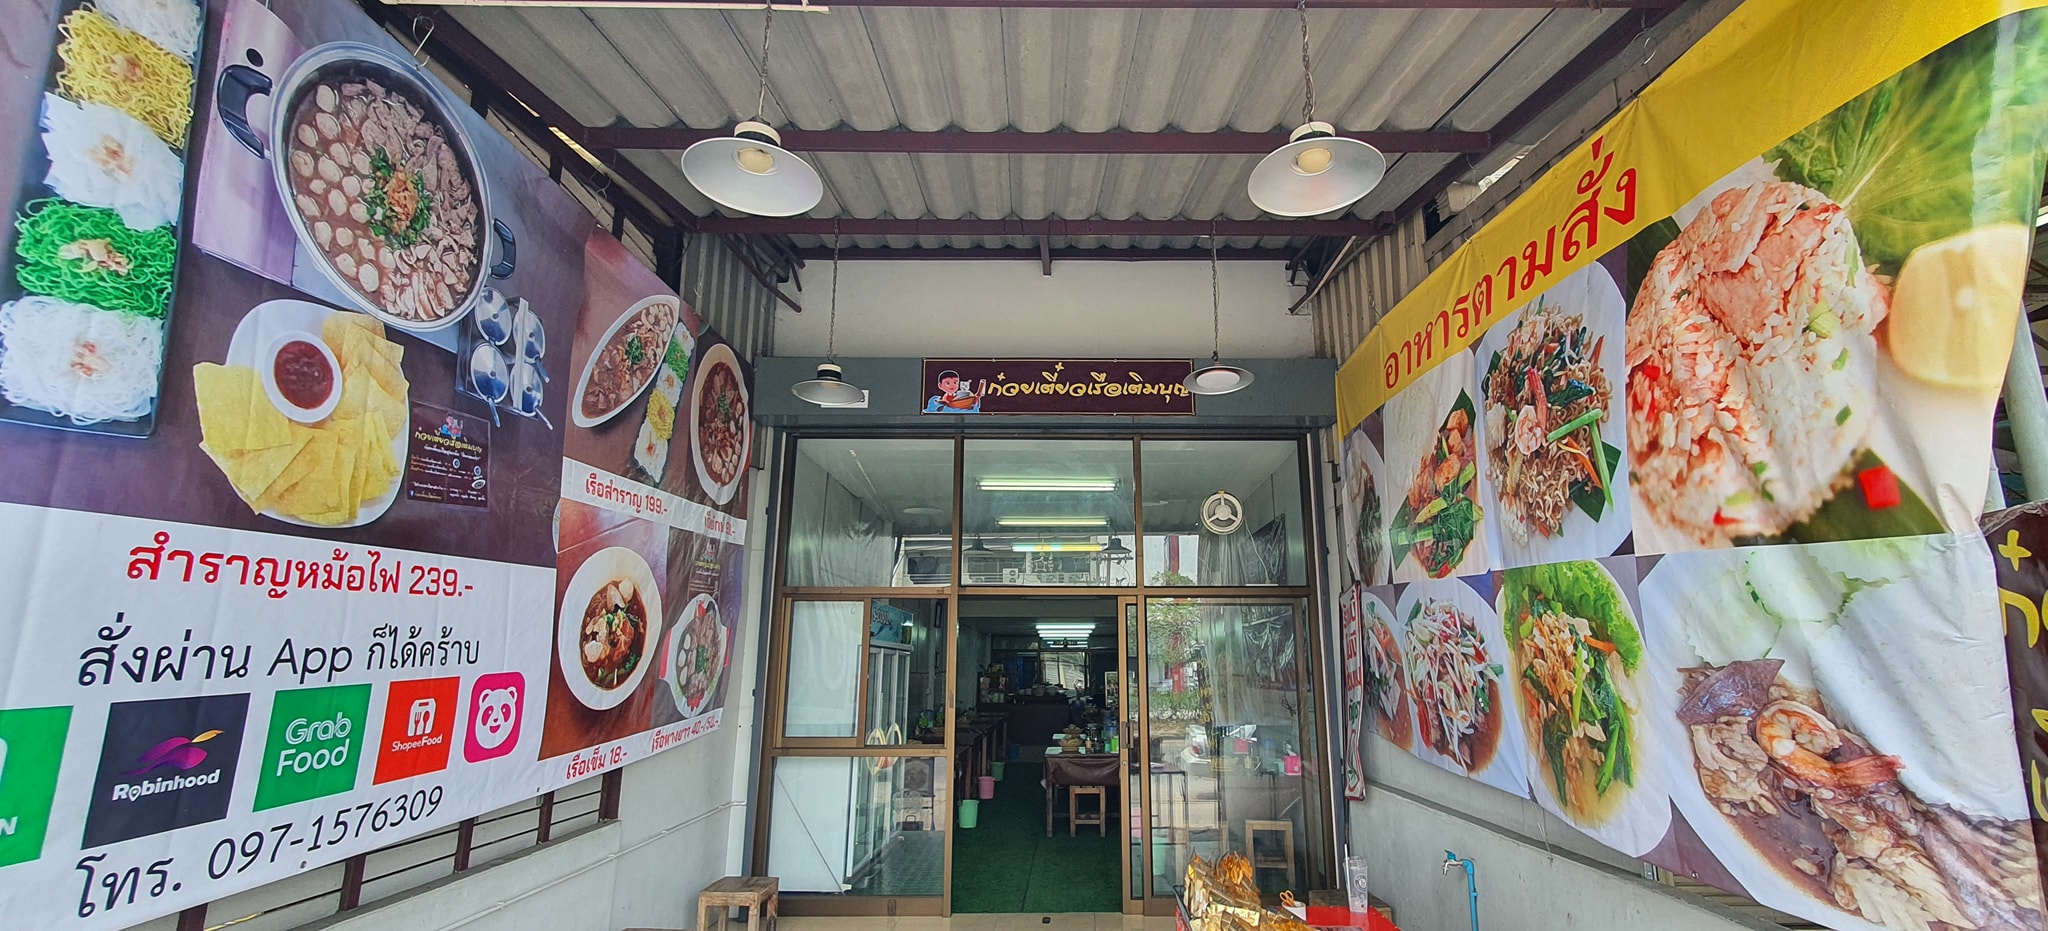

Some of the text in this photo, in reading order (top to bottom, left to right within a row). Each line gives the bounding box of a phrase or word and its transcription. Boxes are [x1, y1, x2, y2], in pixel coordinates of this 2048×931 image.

[1384, 135, 1637, 389] อาหารตามสั่ง
[585, 472, 668, 514] เรือสำราญ 199.-
[126, 531, 474, 599] สำราญหม้อไฟ 239.-
[77, 612, 480, 686] สั่งผ่าน App ก็ได้คร้าบ
[285, 711, 352, 743] Grab
[391, 734, 443, 752] ShopeeFood
[276, 738, 350, 777] Food
[566, 746, 629, 781] เรือเข็ม 18.-
[112, 768, 221, 802] Robinhood
[75, 785, 445, 919] โทร. 097-1576309
